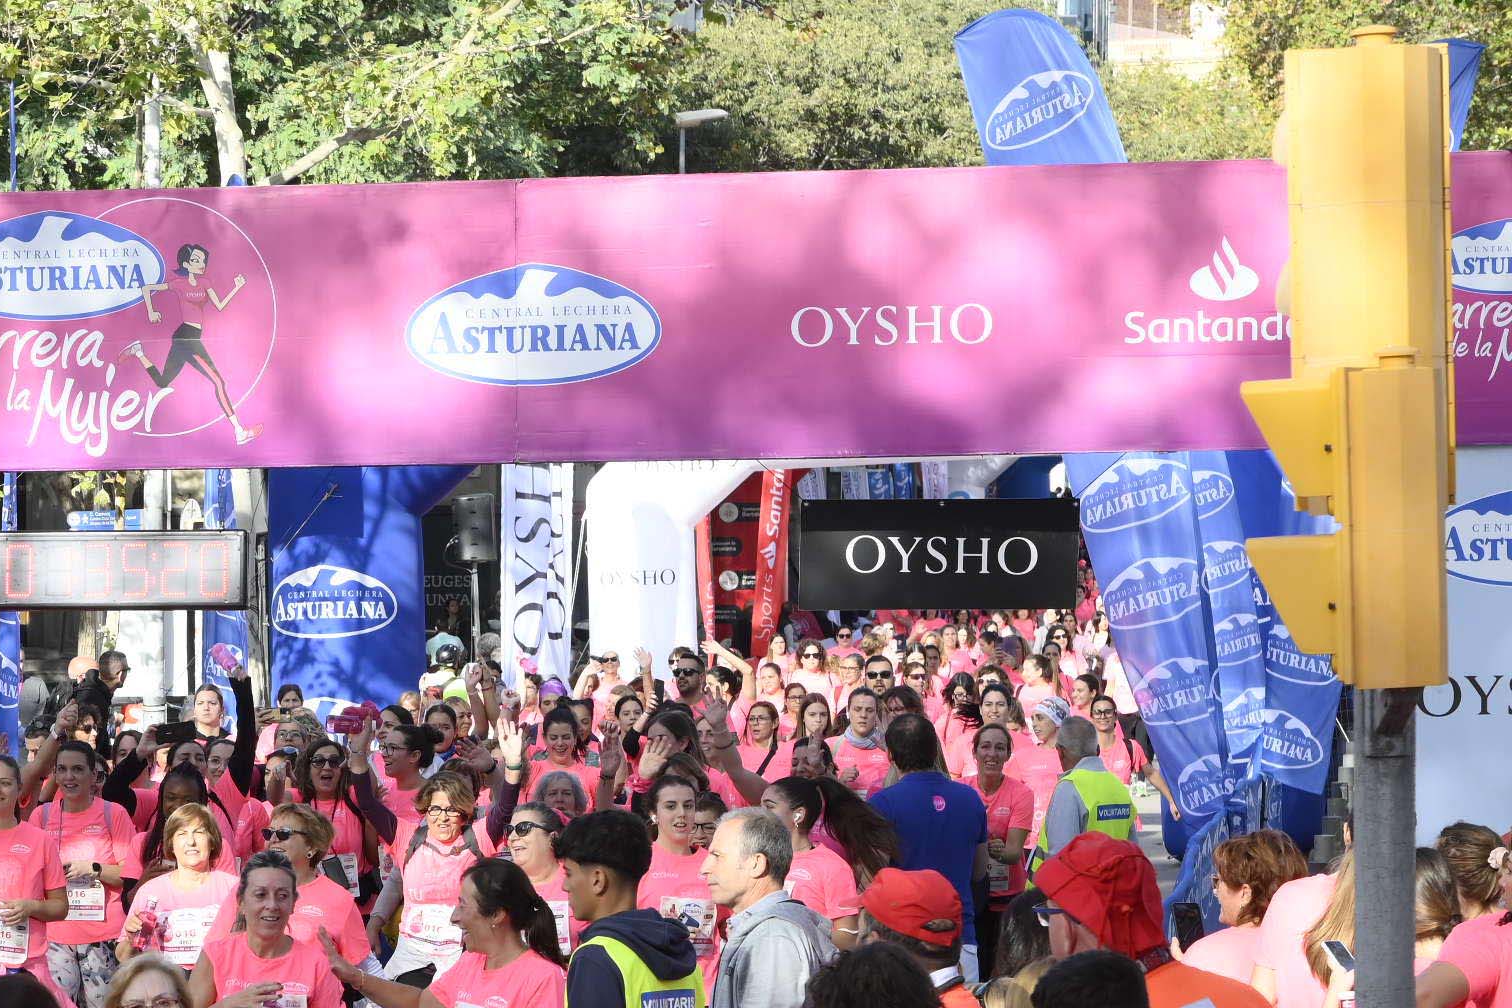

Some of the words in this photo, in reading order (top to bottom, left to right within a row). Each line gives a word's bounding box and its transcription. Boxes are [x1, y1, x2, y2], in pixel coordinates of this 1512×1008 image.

[69, 248, 140, 258] LECHERA
[465, 306, 544, 320] CENTRAL
[552, 304, 633, 317] LECHERA
[427, 311, 641, 354] ASTURIANA
[790, 303, 993, 348] OYSHO
[7, 367, 32, 411] la
[25, 363, 175, 457] Mujer
[845, 535, 1039, 575] OYSHO
[599, 569, 676, 586] OYSHO
[288, 590, 330, 599] CENTRAL
[334, 589, 384, 598] LECHERA
[276, 595, 388, 622] ASTURIANA
[755, 574, 774, 641] Sports
[1098, 805, 1130, 818] VOLUNTARIS
[67, 890, 86, 898] 016
